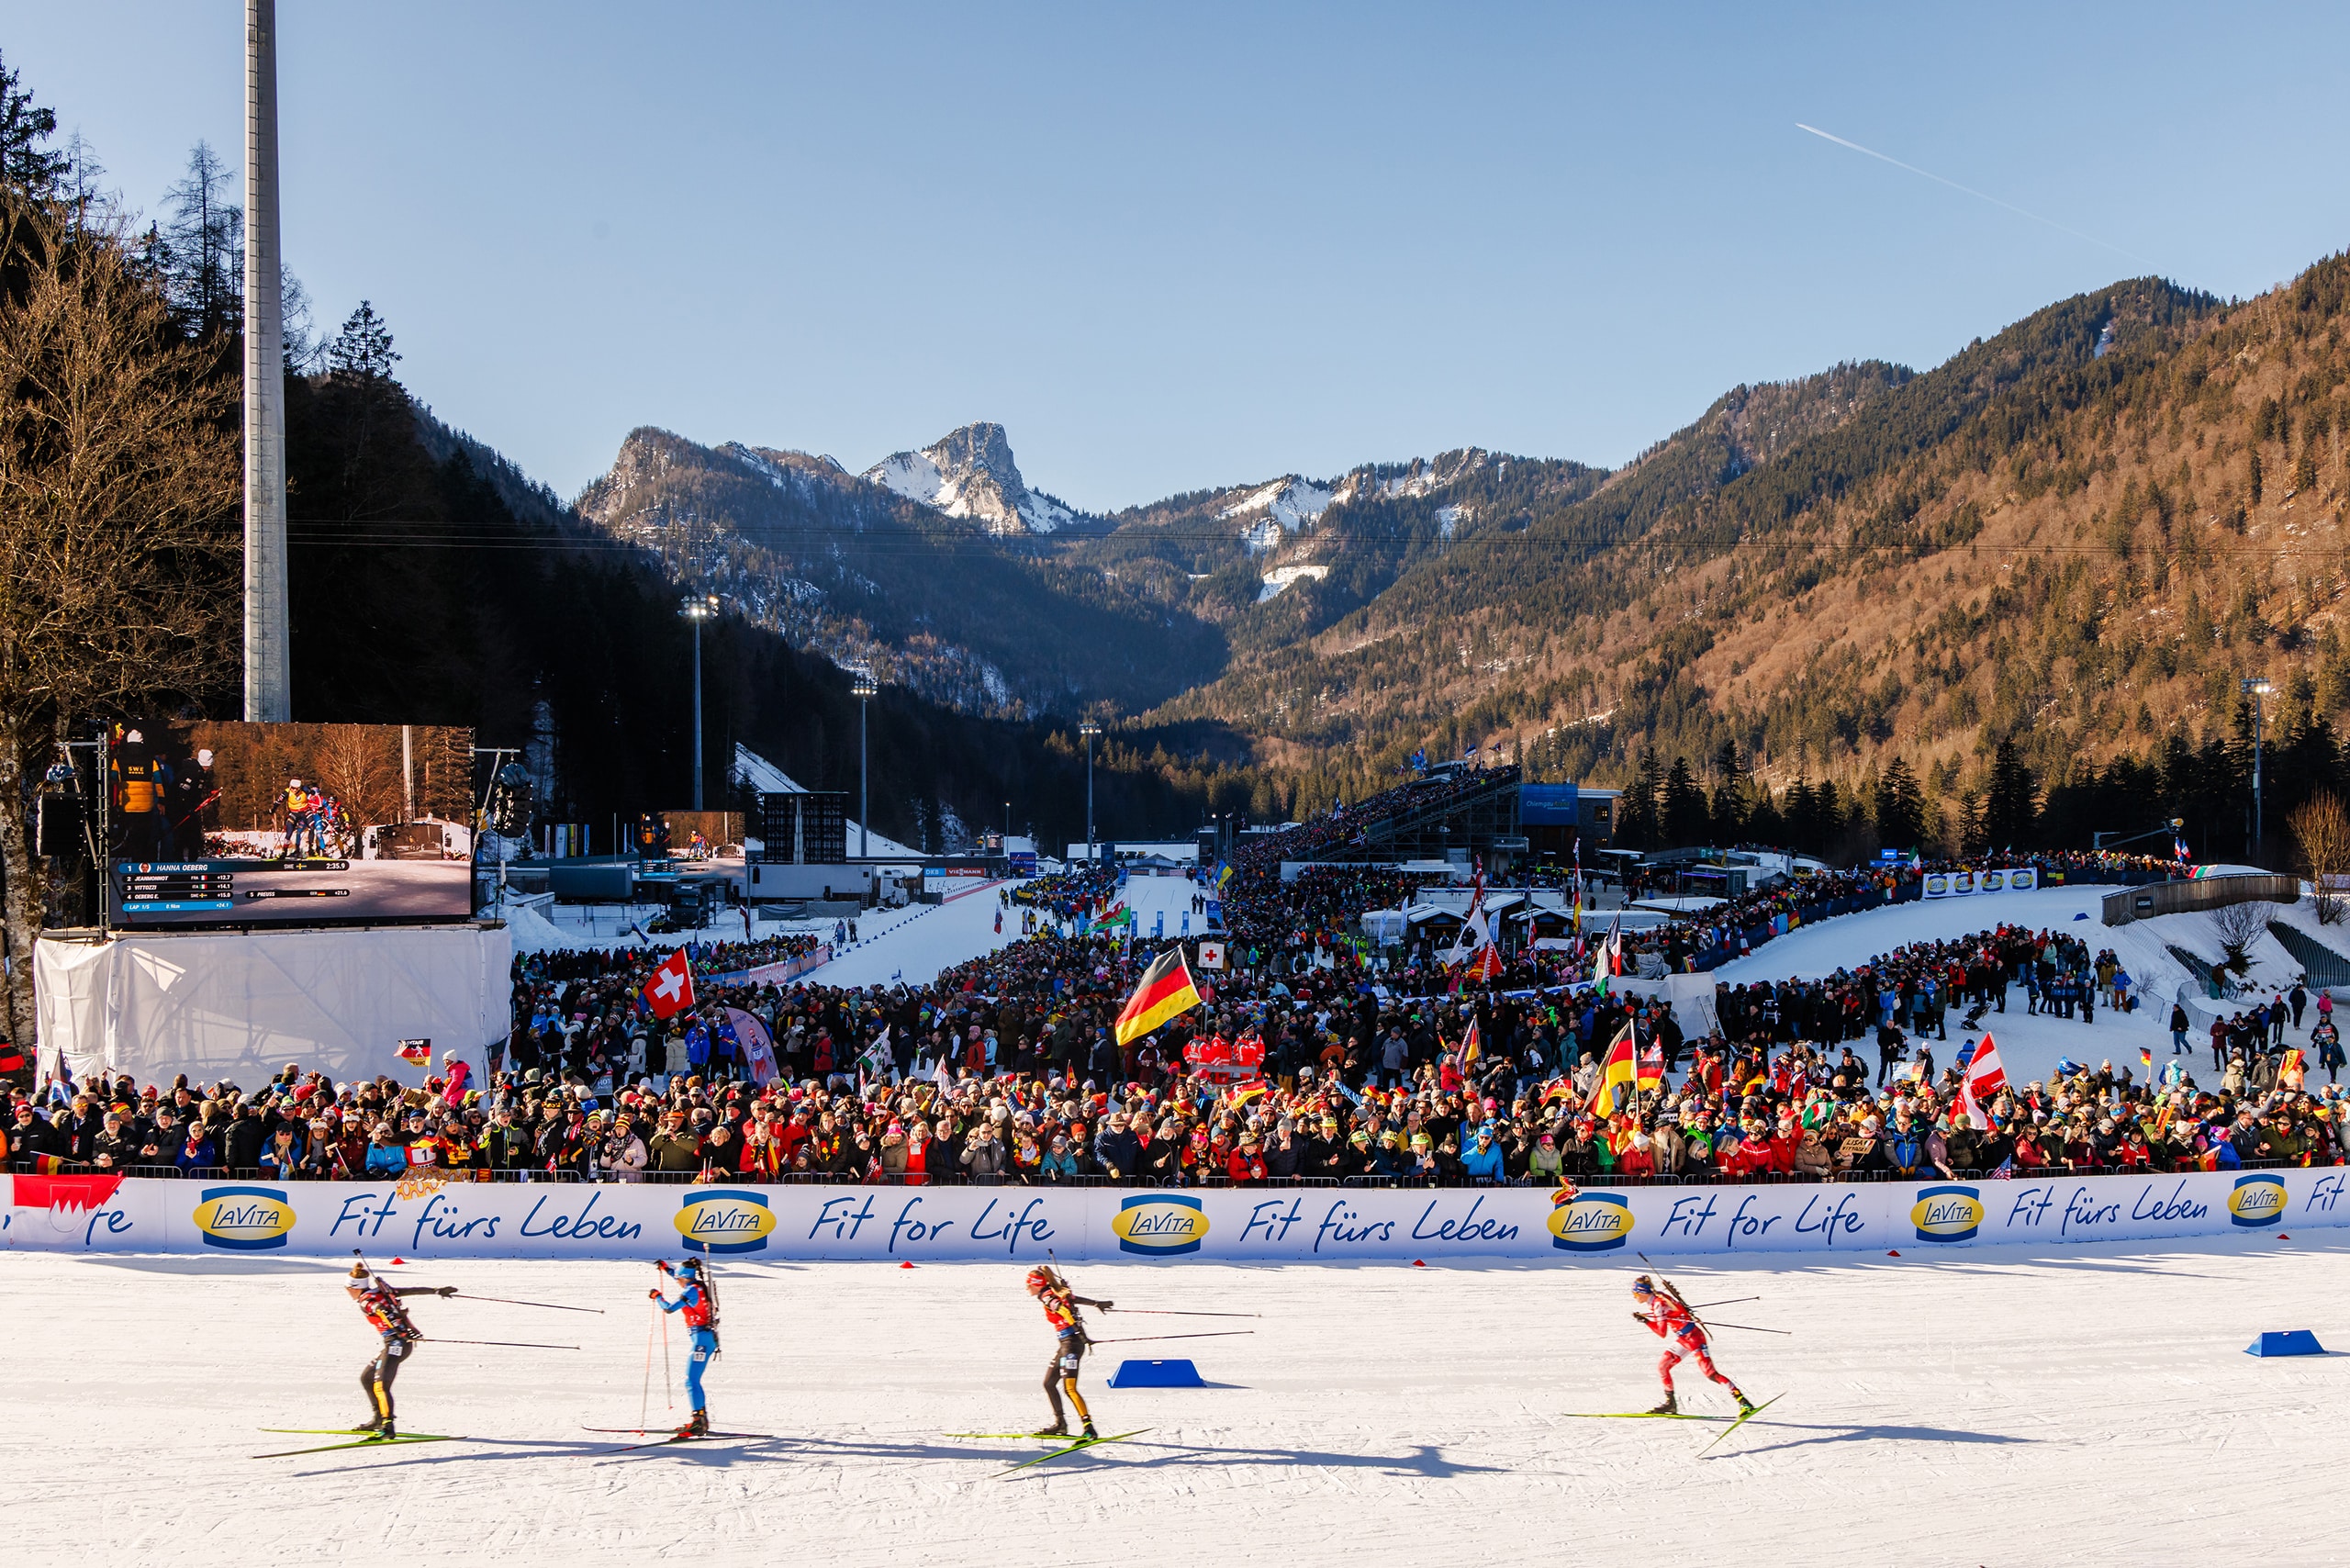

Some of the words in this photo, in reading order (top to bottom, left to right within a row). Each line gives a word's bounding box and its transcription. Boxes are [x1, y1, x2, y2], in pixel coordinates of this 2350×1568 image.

[421, 1149, 428, 1160] 1
[330, 1192, 397, 1237] Fit
[413, 1194, 501, 1250] fürs
[520, 1192, 641, 1239] Leben
[1661, 1194, 1717, 1237] Fit
[1728, 1194, 1782, 1248] for
[1796, 1193, 1864, 1246] Life
[2008, 1185, 2053, 1227] Fit
[2062, 1187, 2120, 1237] fürs
[2132, 1180, 2208, 1221] Leben
[2306, 1173, 2345, 1212] Fit
[809, 1195, 874, 1239] Fit
[889, 1196, 954, 1253] for
[971, 1198, 1055, 1254] Life
[1240, 1197, 1302, 1242] Fit
[1314, 1200, 1394, 1253] fürs
[1412, 1195, 1518, 1241] Leben
